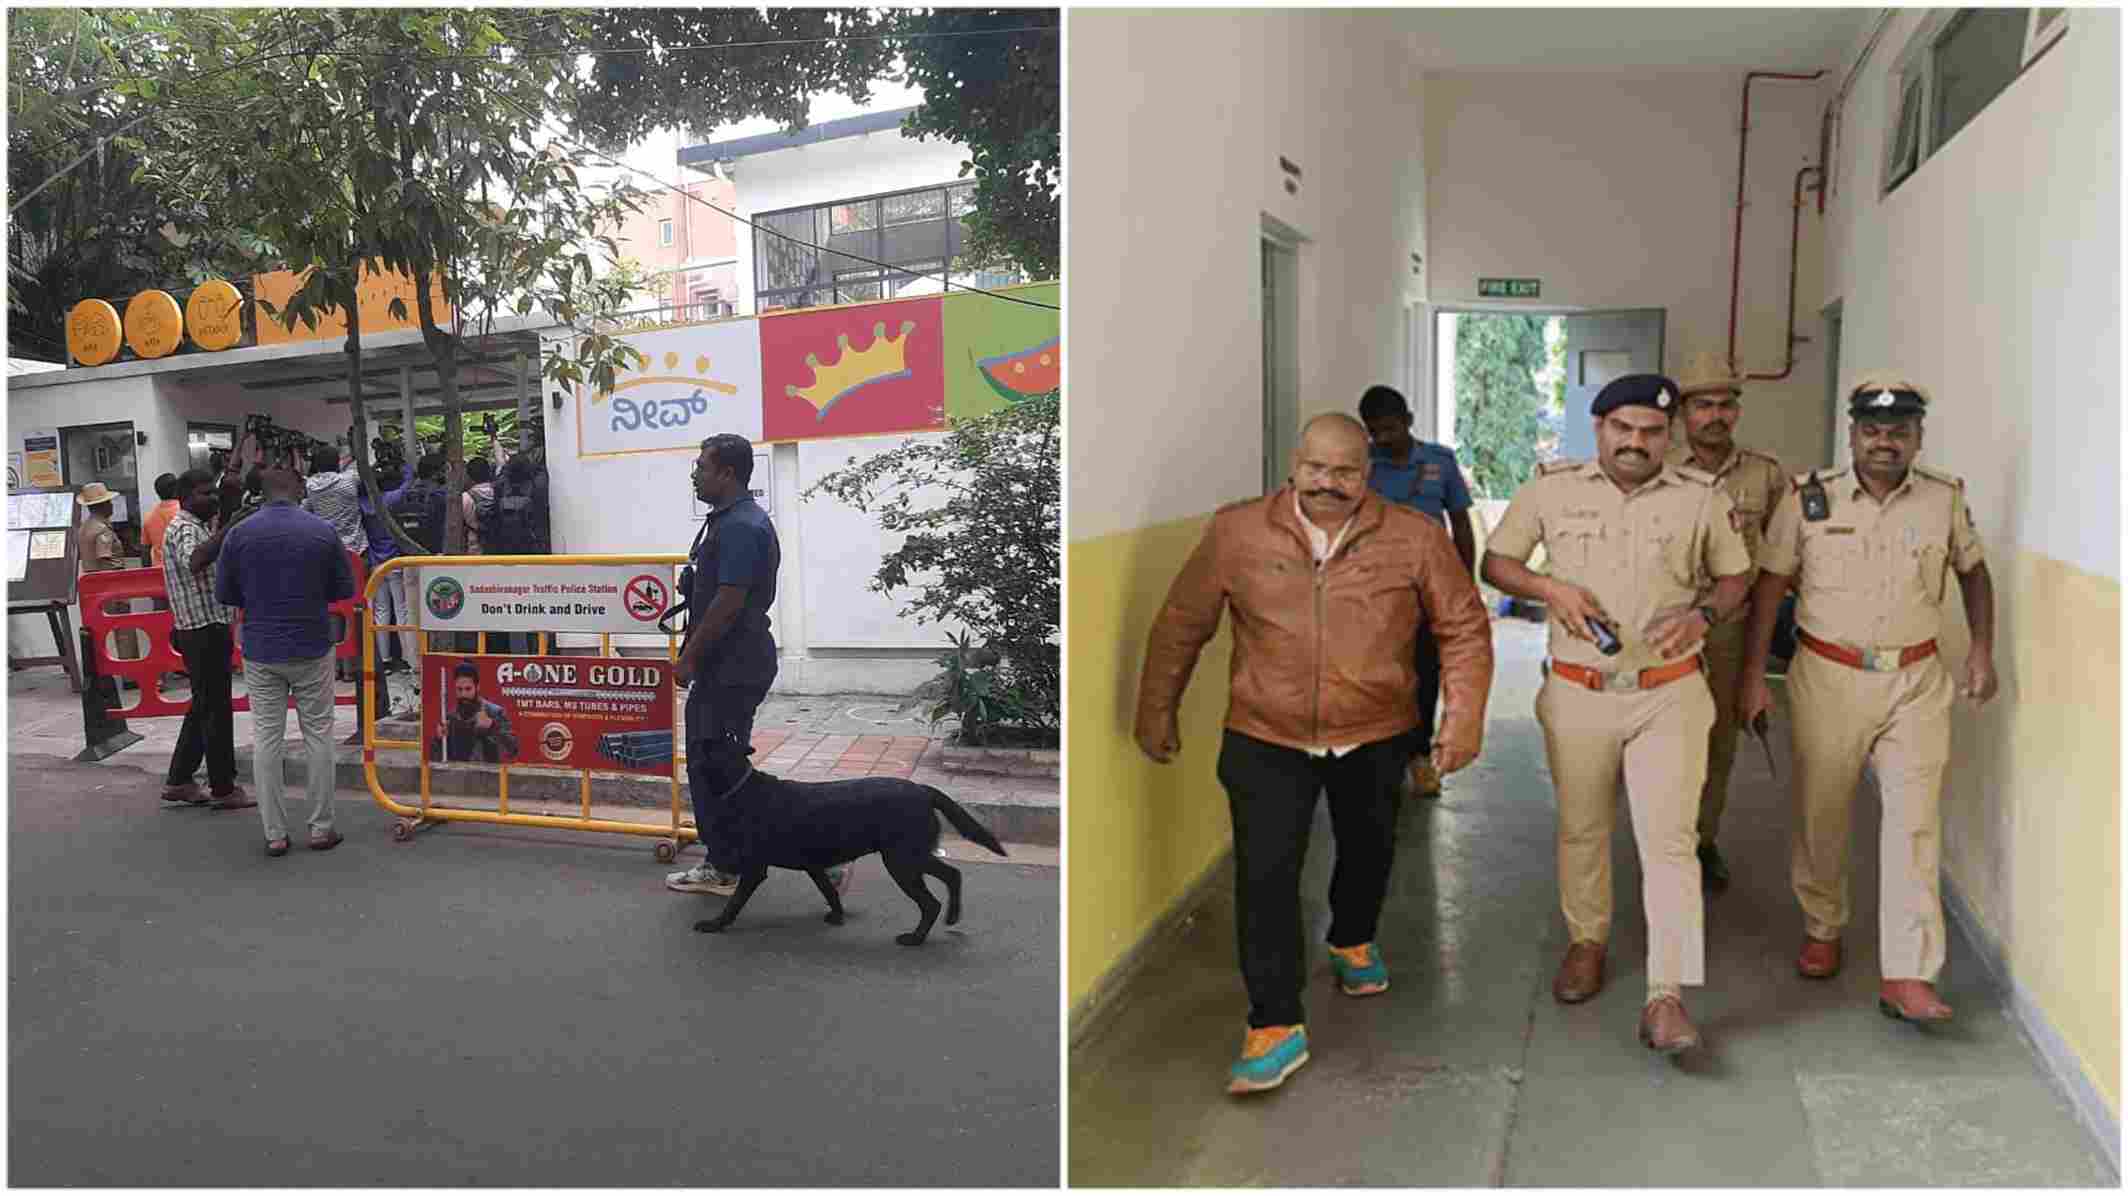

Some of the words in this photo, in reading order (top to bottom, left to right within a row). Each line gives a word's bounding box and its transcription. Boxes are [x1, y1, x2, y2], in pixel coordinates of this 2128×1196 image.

[612, 389, 707, 432] ನೀವ್
[534, 584, 559, 593] Traffic
[562, 584, 586, 593] Police
[588, 584, 617, 593] Station
[481, 604, 511, 614] Don't
[515, 604, 545, 615] Drink
[550, 604, 571, 615] and
[574, 604, 606, 616] Drive
[496, 662, 577, 684] A-ONE
[589, 665, 661, 687] GOLD
[517, 699, 532, 708] TMT
[579, 701, 608, 712] TUBES
[611, 703, 619, 712] &
[620, 703, 647, 712] PIPES
